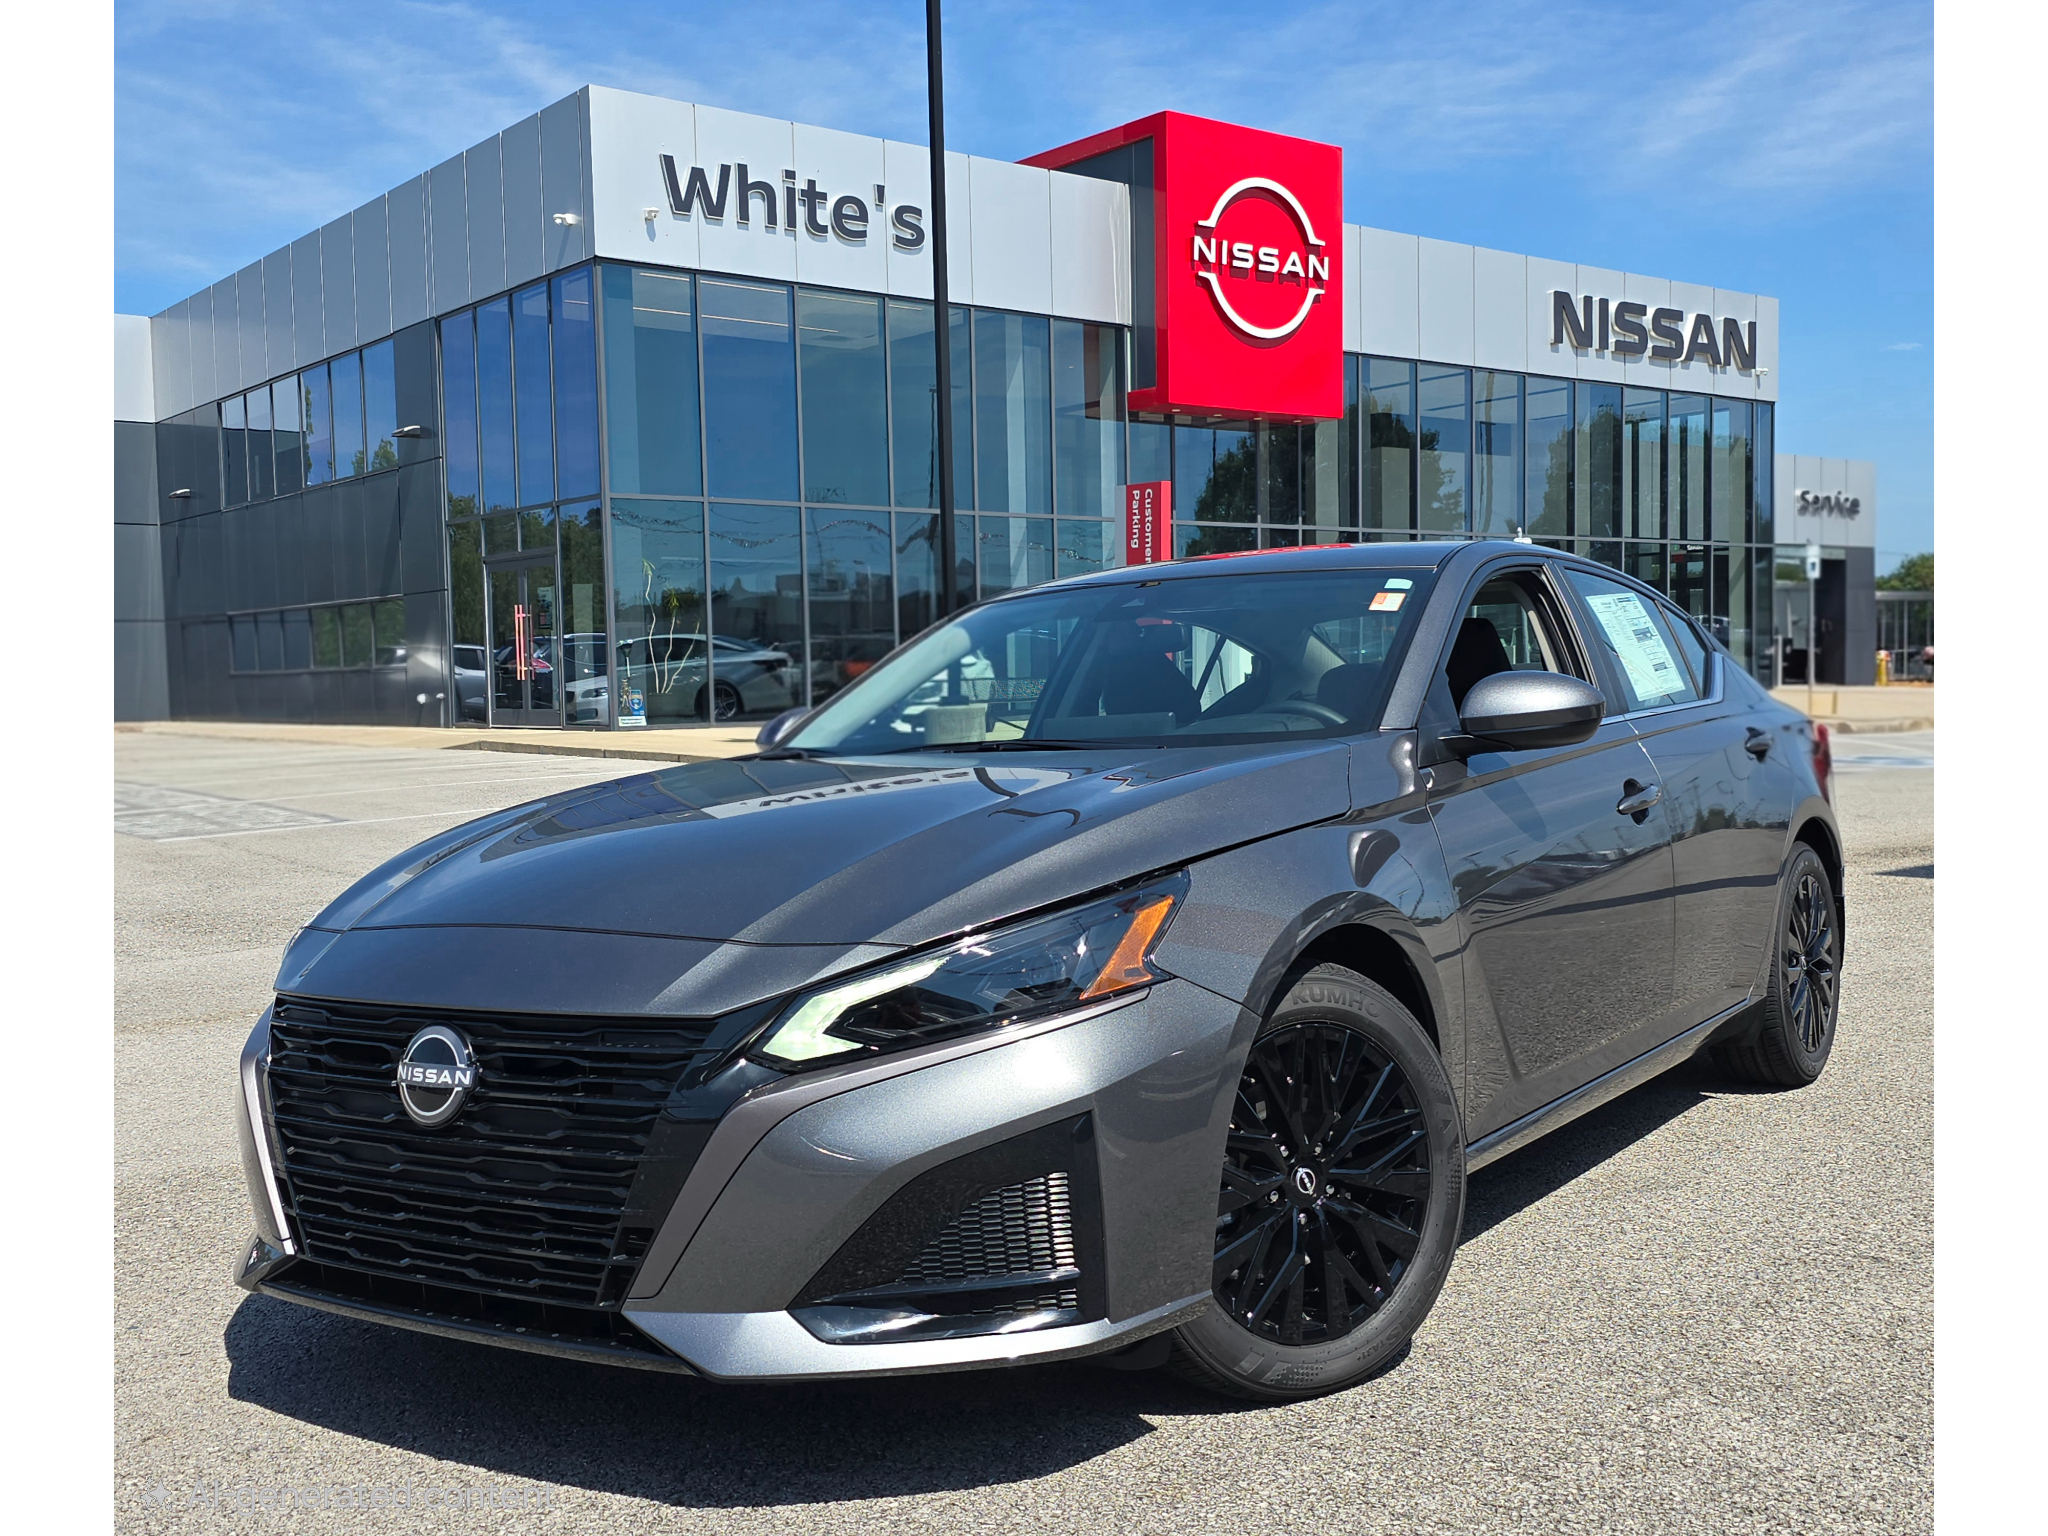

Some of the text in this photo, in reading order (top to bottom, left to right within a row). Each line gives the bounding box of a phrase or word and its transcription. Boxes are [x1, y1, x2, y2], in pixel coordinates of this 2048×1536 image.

[659, 153, 926, 249] White's
[1193, 235, 1330, 281] NISSAN
[1549, 290, 1757, 370] NISSAN
[1131, 489, 1141, 548] Parking
[1144, 488, 1153, 563] Customer
[1799, 489, 1861, 516] Service
[1290, 985, 1381, 1018] KUMHO
[398, 1064, 471, 1085] NISSAN
